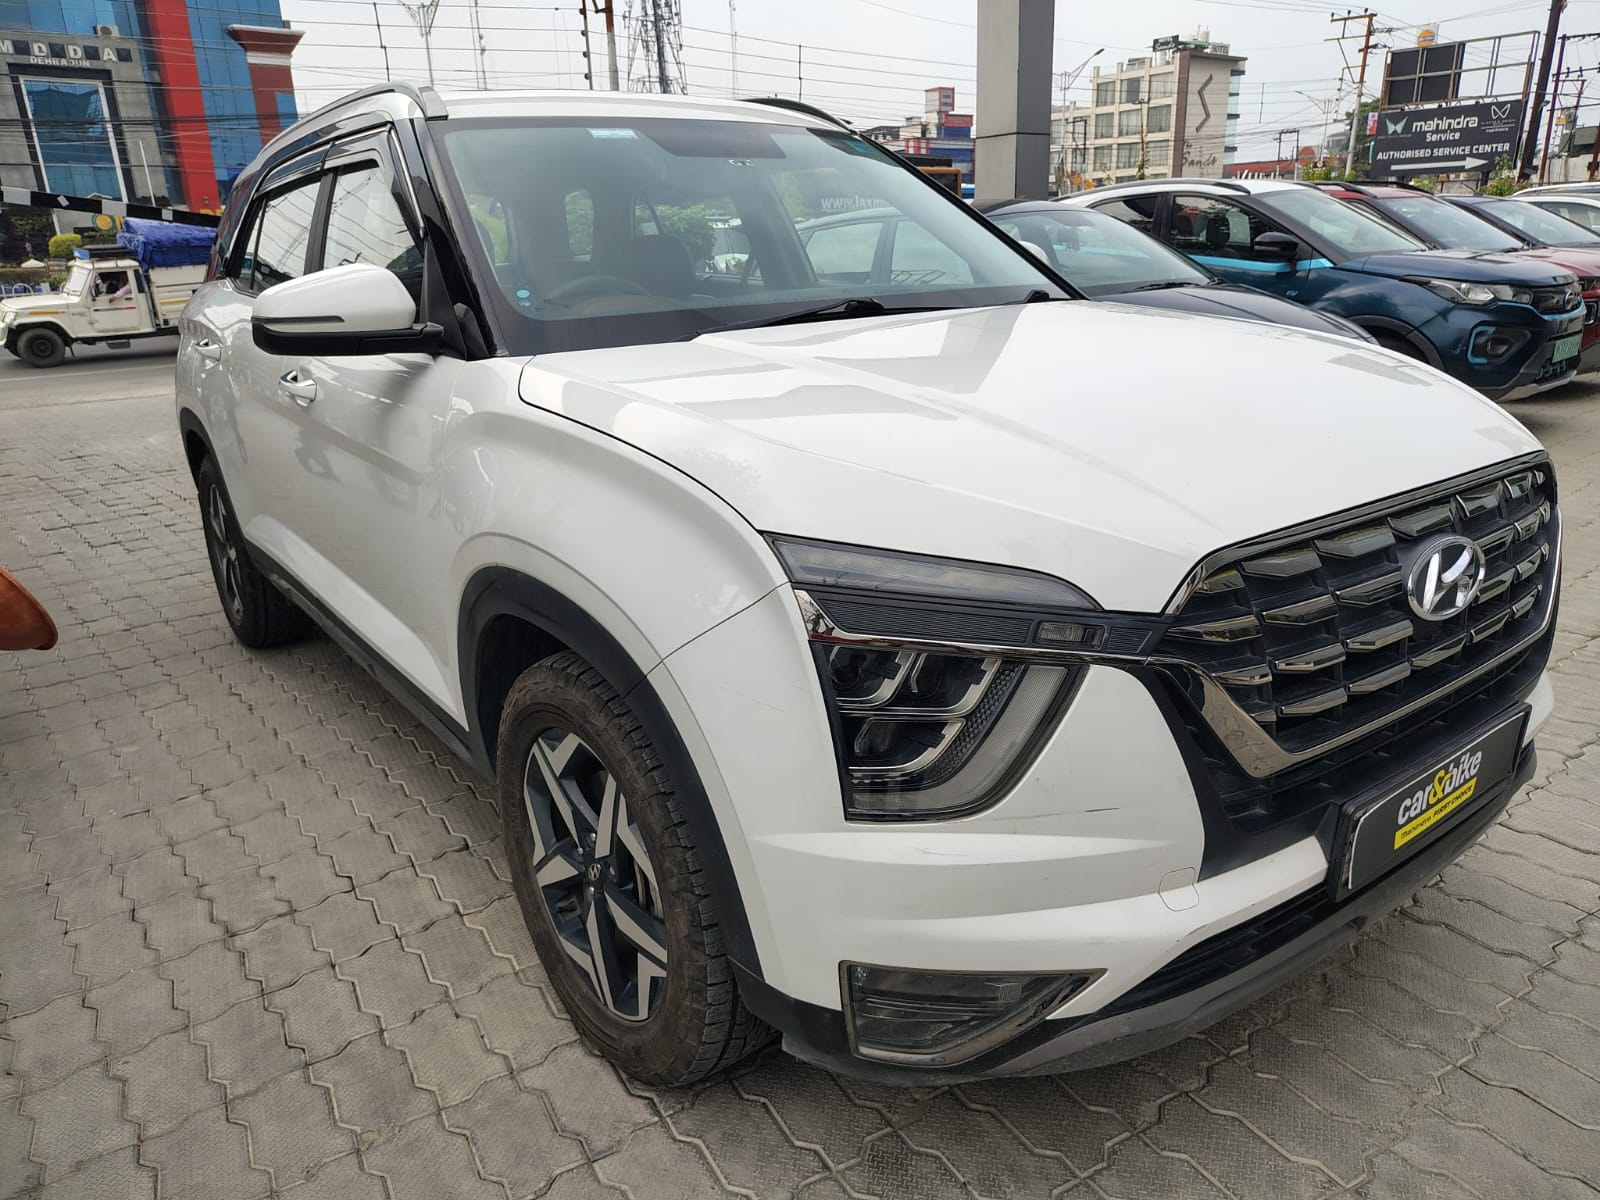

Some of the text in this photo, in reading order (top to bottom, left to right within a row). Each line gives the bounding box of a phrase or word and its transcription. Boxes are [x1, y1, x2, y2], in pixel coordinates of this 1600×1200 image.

[1412, 115, 1478, 132] mahindra
[1426, 130, 1460, 142] Service
[1376, 142, 1510, 160] AUTHORISED SERVICE CENTER
